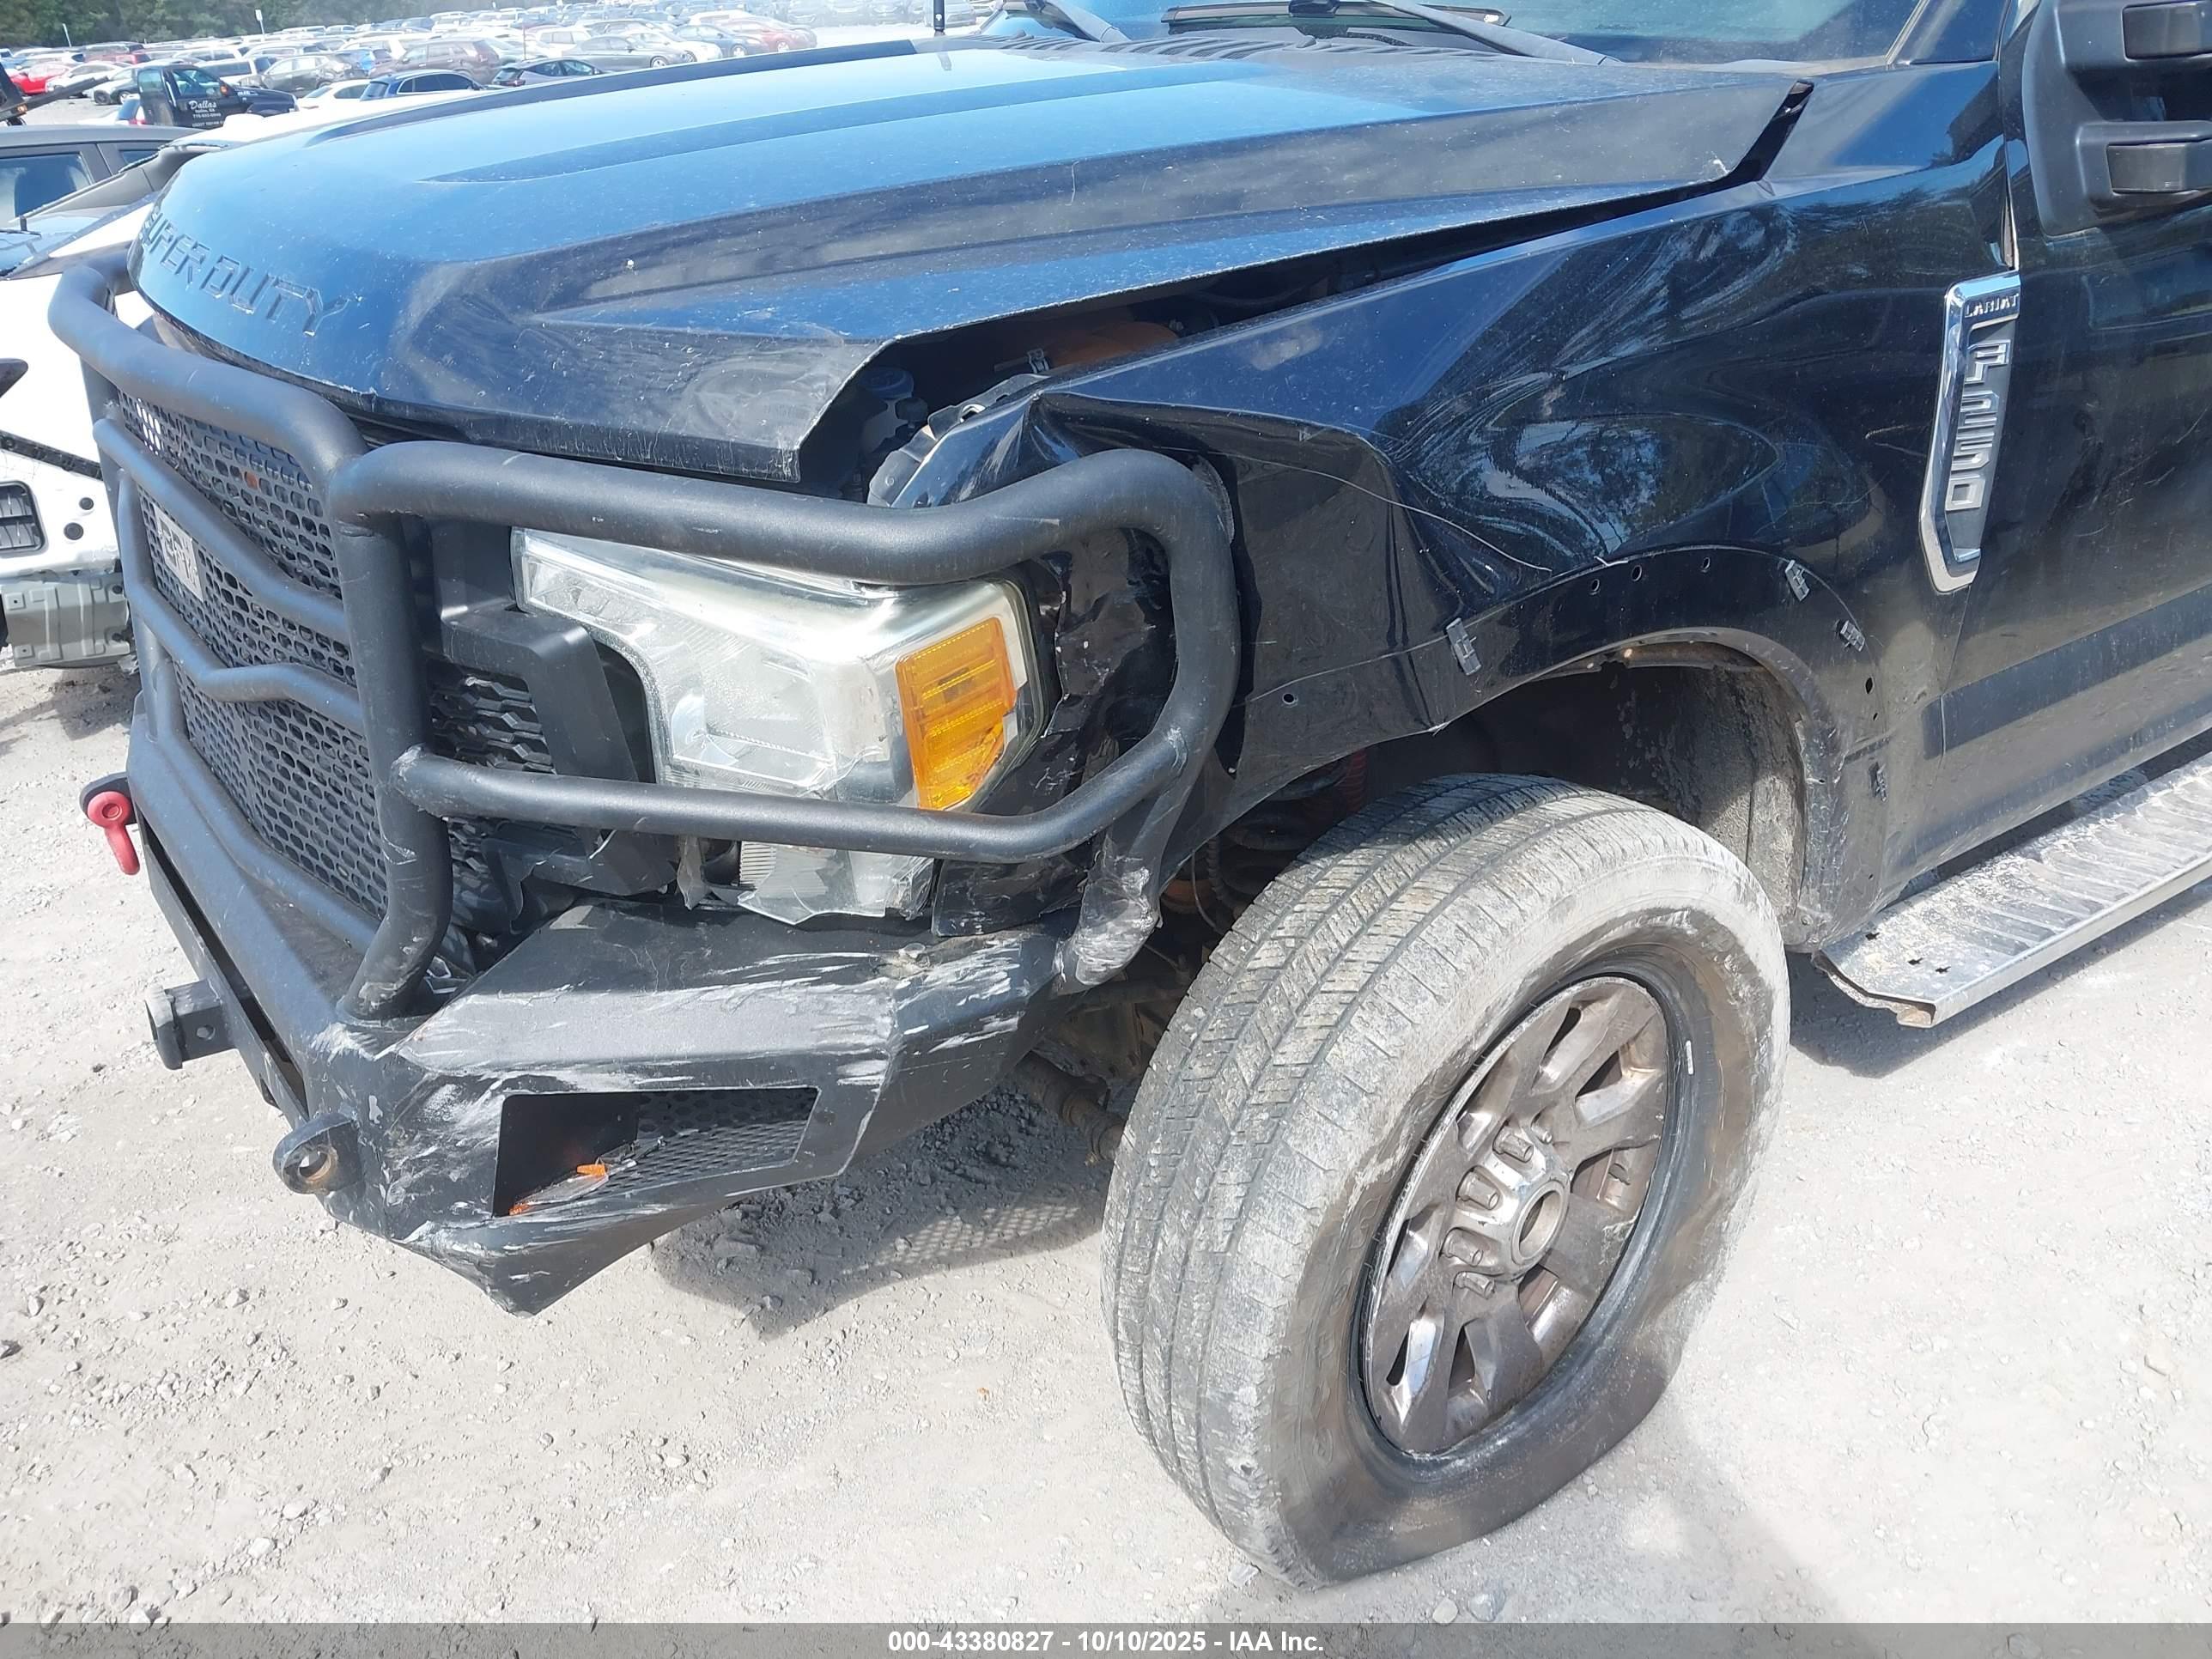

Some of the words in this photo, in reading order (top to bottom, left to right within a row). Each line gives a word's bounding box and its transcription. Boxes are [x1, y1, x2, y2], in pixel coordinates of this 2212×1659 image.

[189, 100, 216, 110] Dallas
[199, 253, 350, 337] DUTY
[1964, 293, 2020, 318] LARIAT
